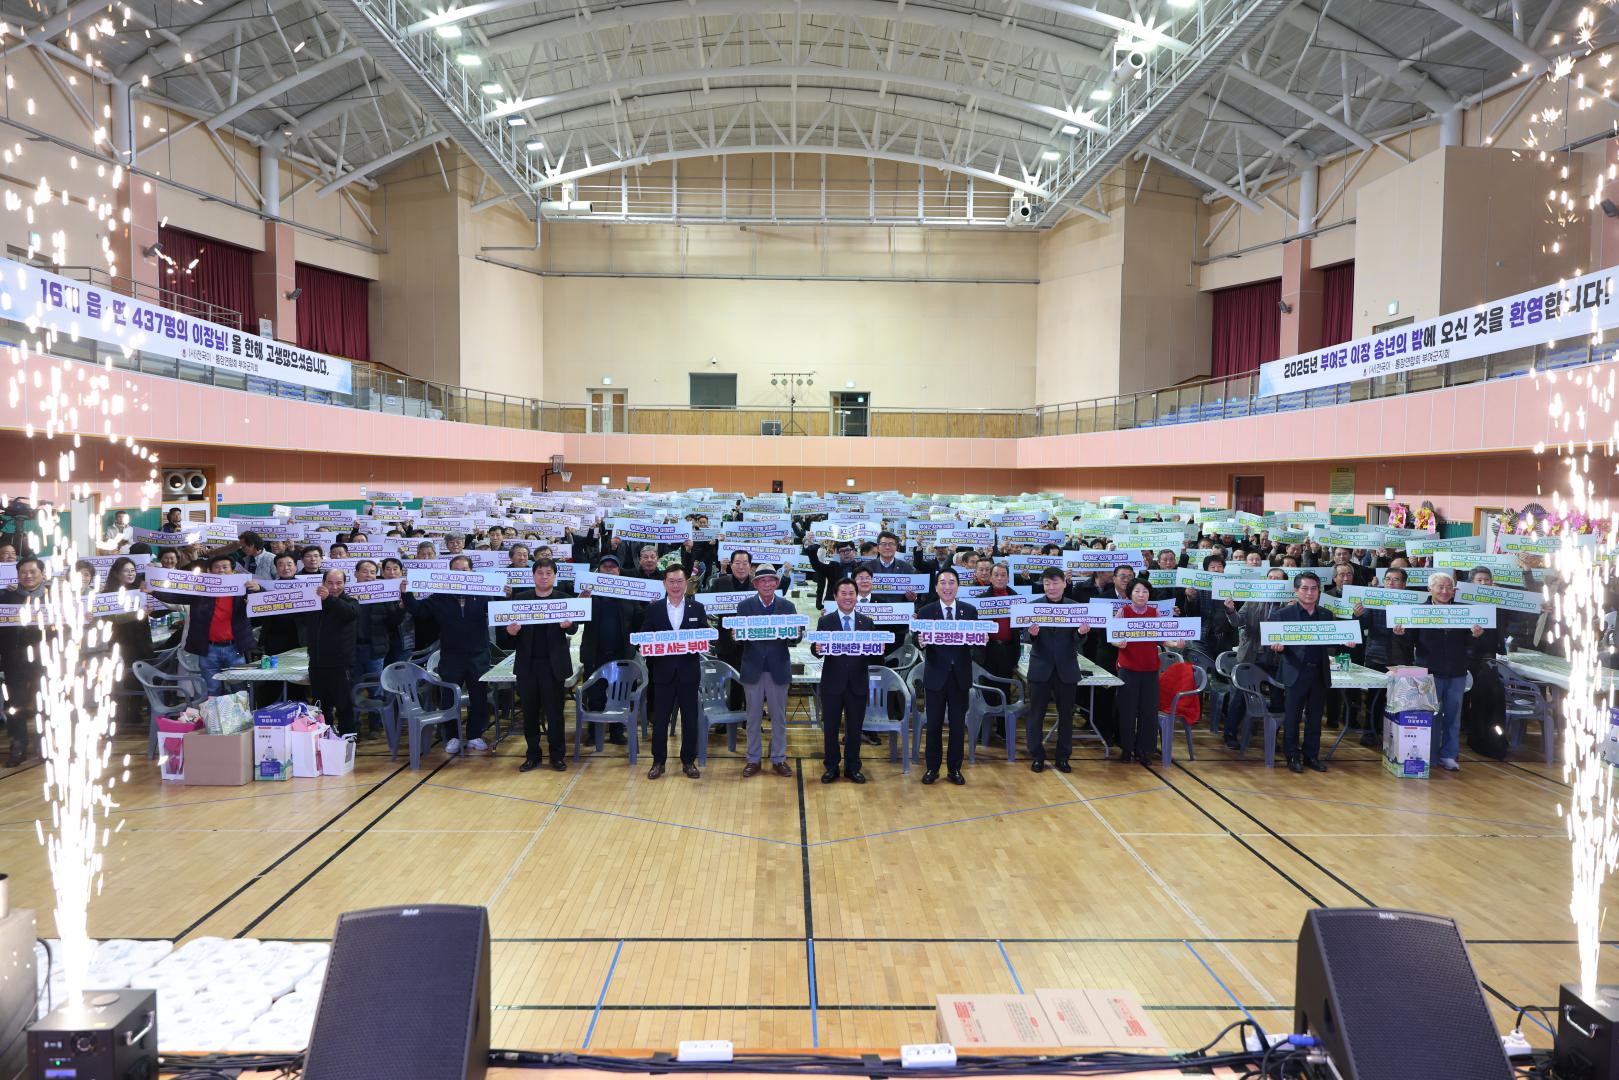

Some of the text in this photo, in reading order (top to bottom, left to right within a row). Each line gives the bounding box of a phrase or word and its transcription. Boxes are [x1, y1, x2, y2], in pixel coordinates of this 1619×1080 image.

[132, 308, 188, 342] 437명의
[192, 323, 228, 351] 이장님!
[232, 334, 242, 355] 올
[244, 338, 263, 360] 한해
[266, 344, 330, 376] 고생많으셨습니다.
[1284, 356, 1318, 378] 2025년
[1320, 349, 1348, 372] 부여군
[1351, 342, 1370, 364] 이장
[1374, 332, 1406, 360] 송년의
[1412, 325, 1436, 351] 밤에
[1441, 317, 1468, 344] 오신
[1474, 306, 1504, 337] 것을
[450, 574, 465, 582] 437명
[512, 604, 531, 612] 부여군
[532, 603, 548, 611] 437명
[1034, 607, 1052, 615] 부여군
[724, 615, 808, 627] 부여군 이장과 함께 만드는
[911, 622, 998, 631] 부여군 이장과 함께 만드는
[1128, 621, 1144, 629] 부여군
[631, 630, 718, 642] 부여군 이장과 함께 만드는
[735, 627, 798, 639] 더 청렴한 부여
[808, 633, 894, 642] 부여군 이장과 함께 만드는
[923, 632, 985, 643] 더 공정한 부여
[642, 641, 707, 655] 더 잘 사는 부여
[832, 643, 861, 654] 행복한
[863, 643, 882, 654] 부여
